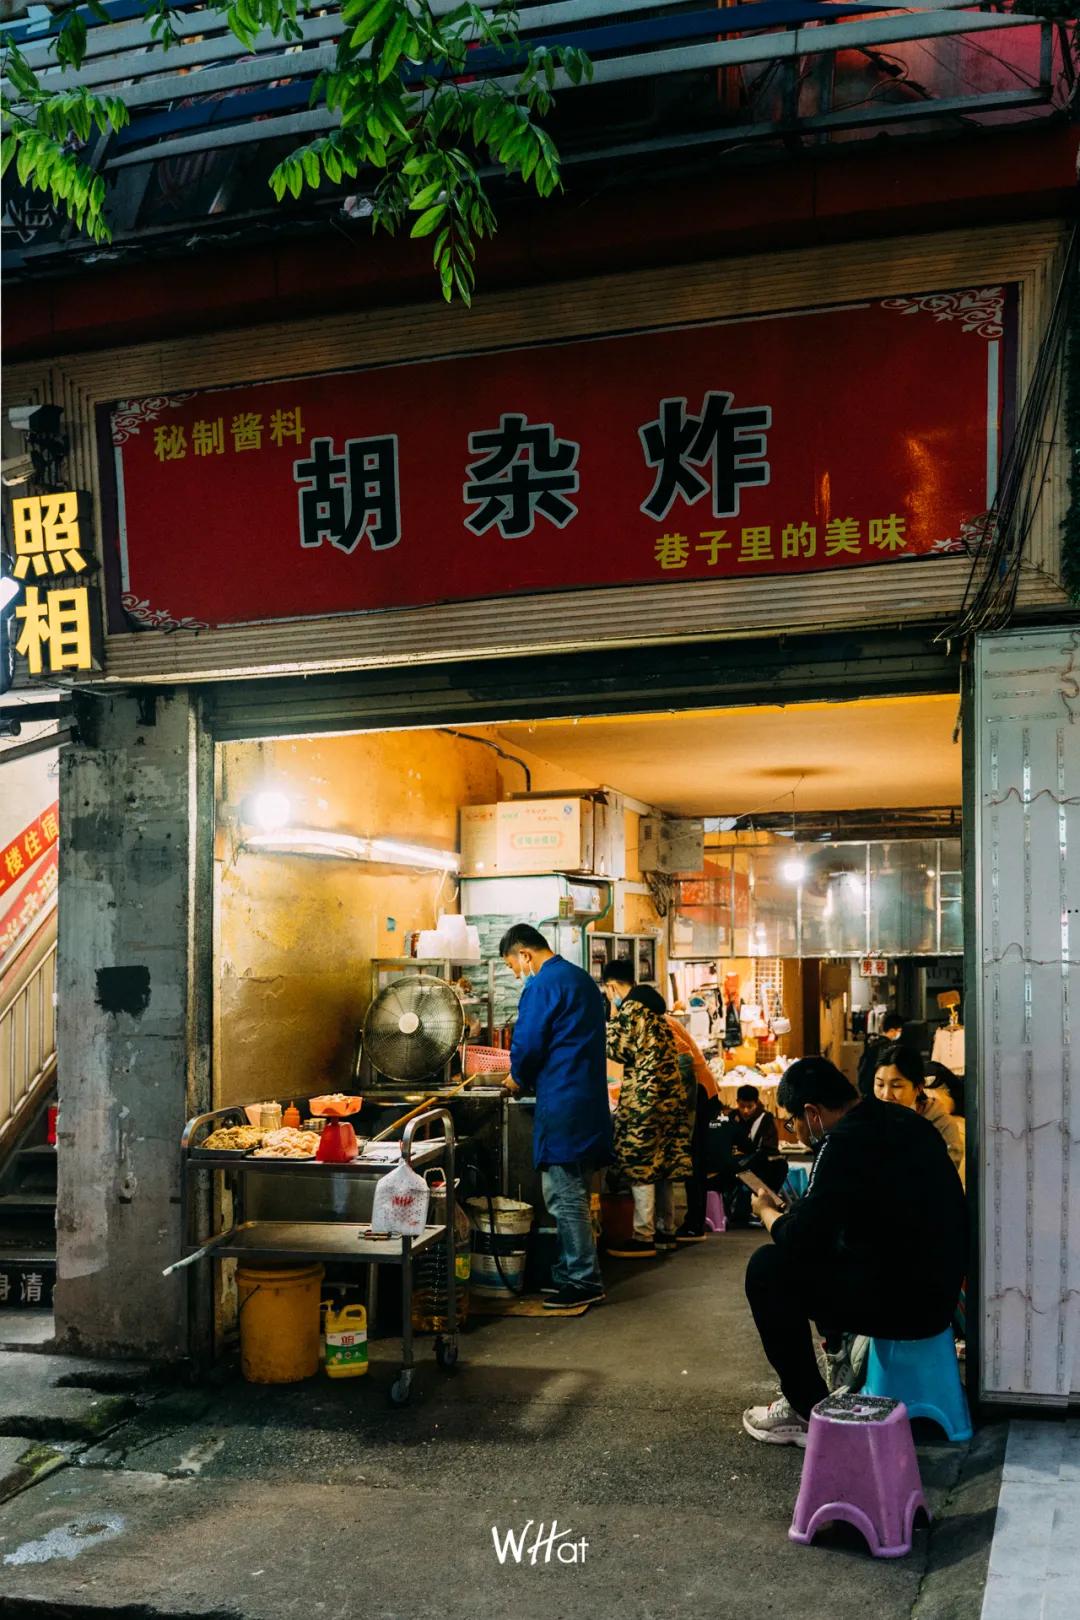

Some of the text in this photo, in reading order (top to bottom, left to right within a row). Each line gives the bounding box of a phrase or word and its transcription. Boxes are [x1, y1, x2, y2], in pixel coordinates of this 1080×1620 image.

[153, 406, 305, 462] 秘制酱料
[294, 390, 772, 553] 胡杂炸
[654, 513, 907, 570] 巷子里的美味
[12, 491, 92, 674] 照相
[0, 812, 58, 888] 楼住宿
